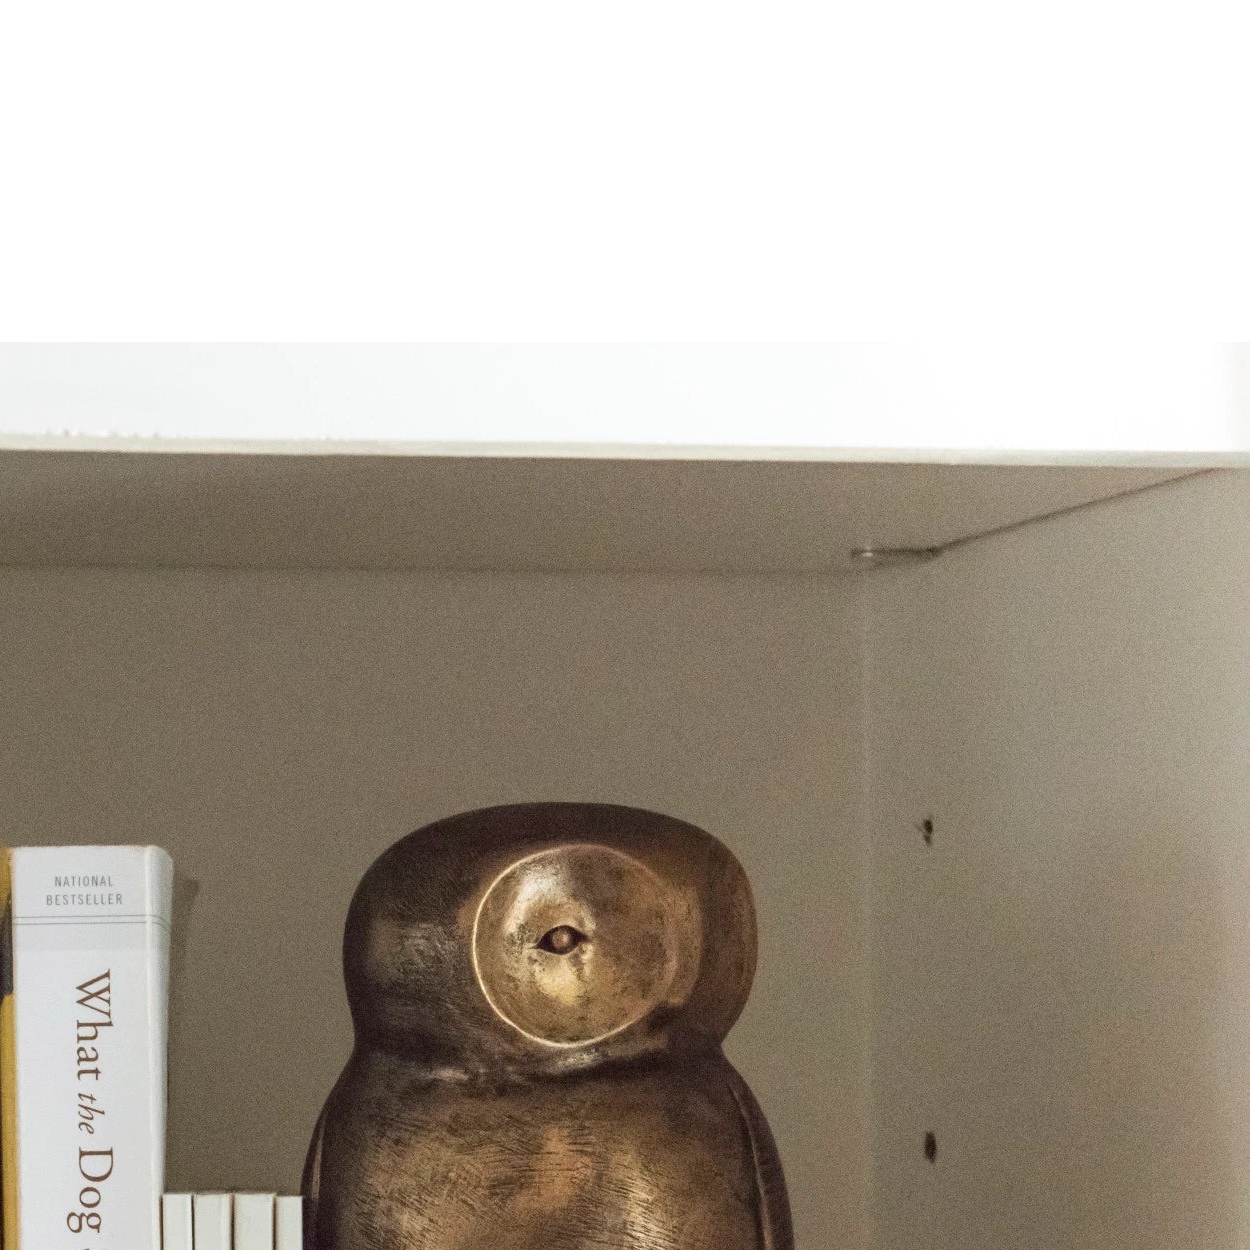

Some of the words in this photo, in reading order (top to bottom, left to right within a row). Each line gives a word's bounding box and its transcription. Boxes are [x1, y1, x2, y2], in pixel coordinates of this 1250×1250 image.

[46, 893, 123, 906] BESTSELLER
[54, 875, 114, 888] NATIONAL
[75, 968, 114, 1082] What
[77, 1092, 106, 1135] the
[66, 1146, 114, 1234] Dog
